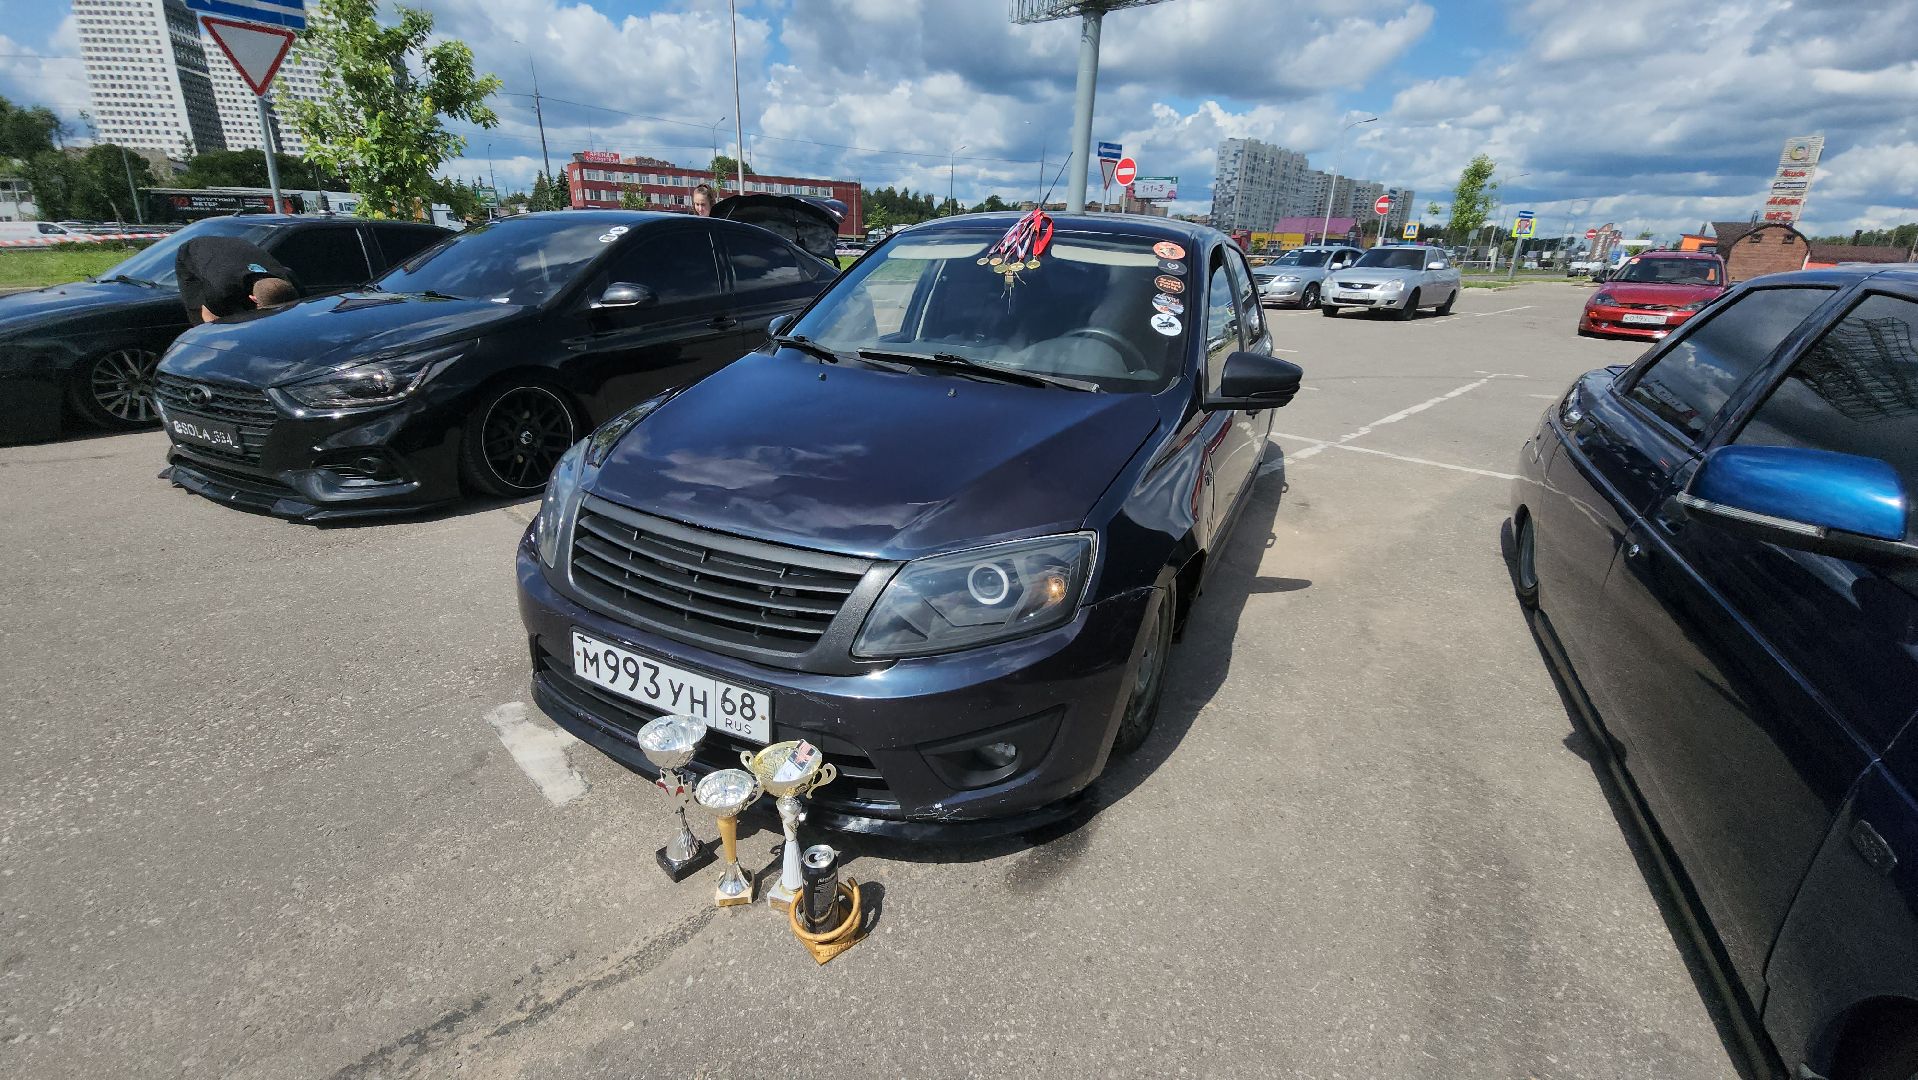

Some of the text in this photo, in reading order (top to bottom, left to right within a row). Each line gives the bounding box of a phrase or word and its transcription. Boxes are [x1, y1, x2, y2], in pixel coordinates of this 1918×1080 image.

[582, 646, 757, 722] М993УН 68
[725, 717, 752, 735] RUS
